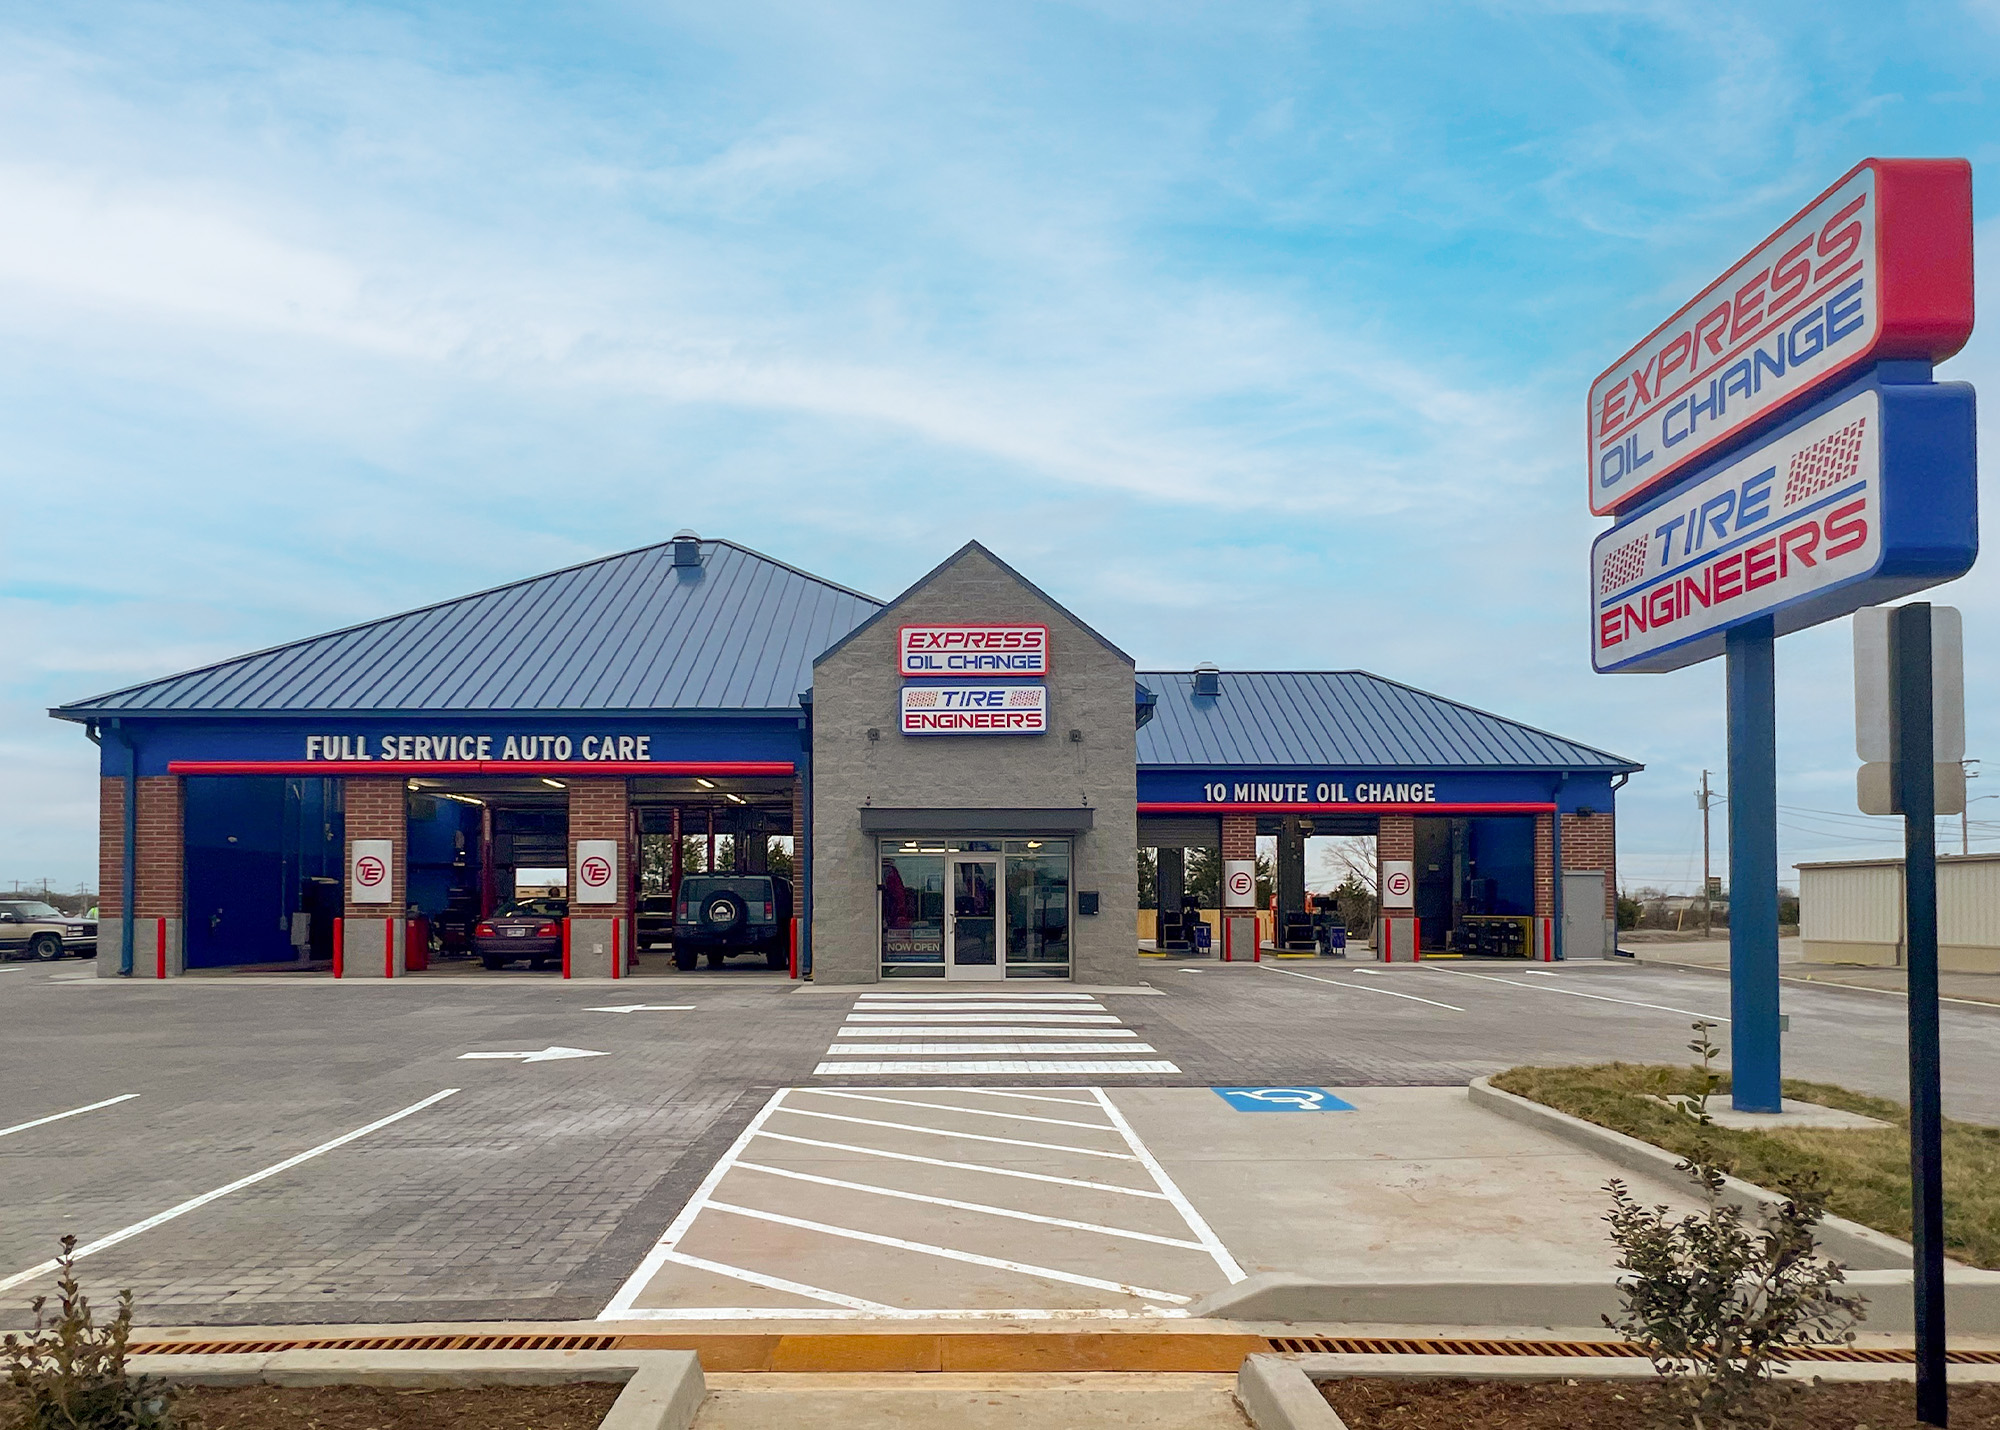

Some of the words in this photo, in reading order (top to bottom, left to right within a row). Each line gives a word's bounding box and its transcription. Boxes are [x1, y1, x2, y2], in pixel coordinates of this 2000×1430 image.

[1599, 193, 1867, 434] EXPRESS
[1600, 434, 1654, 489] OIL
[1662, 279, 1865, 446] CHANGE
[1655, 466, 1776, 567] TIRE
[1601, 498, 1867, 649] ENGINEERS
[907, 631, 1043, 649] EXPRESS
[907, 655, 943, 670] OIL
[948, 655, 1042, 670] CHANGE
[942, 690, 1006, 707] TIRE
[905, 713, 1043, 729] ENGINEERS
[306, 735, 373, 761] FULL
[381, 735, 493, 761] SERVICE
[502, 735, 573, 761] AUTO
[582, 735, 651, 761] CARE
[1204, 783, 1227, 802] 10
[1234, 783, 1308, 802] MINUTE
[1316, 783, 1349, 802] OIL
[1355, 783, 1436, 802] CHANGE
[359, 863, 382, 881] TE
[584, 863, 608, 881] TE
[1235, 878, 1248, 889] E
[1393, 878, 1406, 890] E
[887, 942, 912, 952] NOW
[913, 942, 940, 952] OPEN
